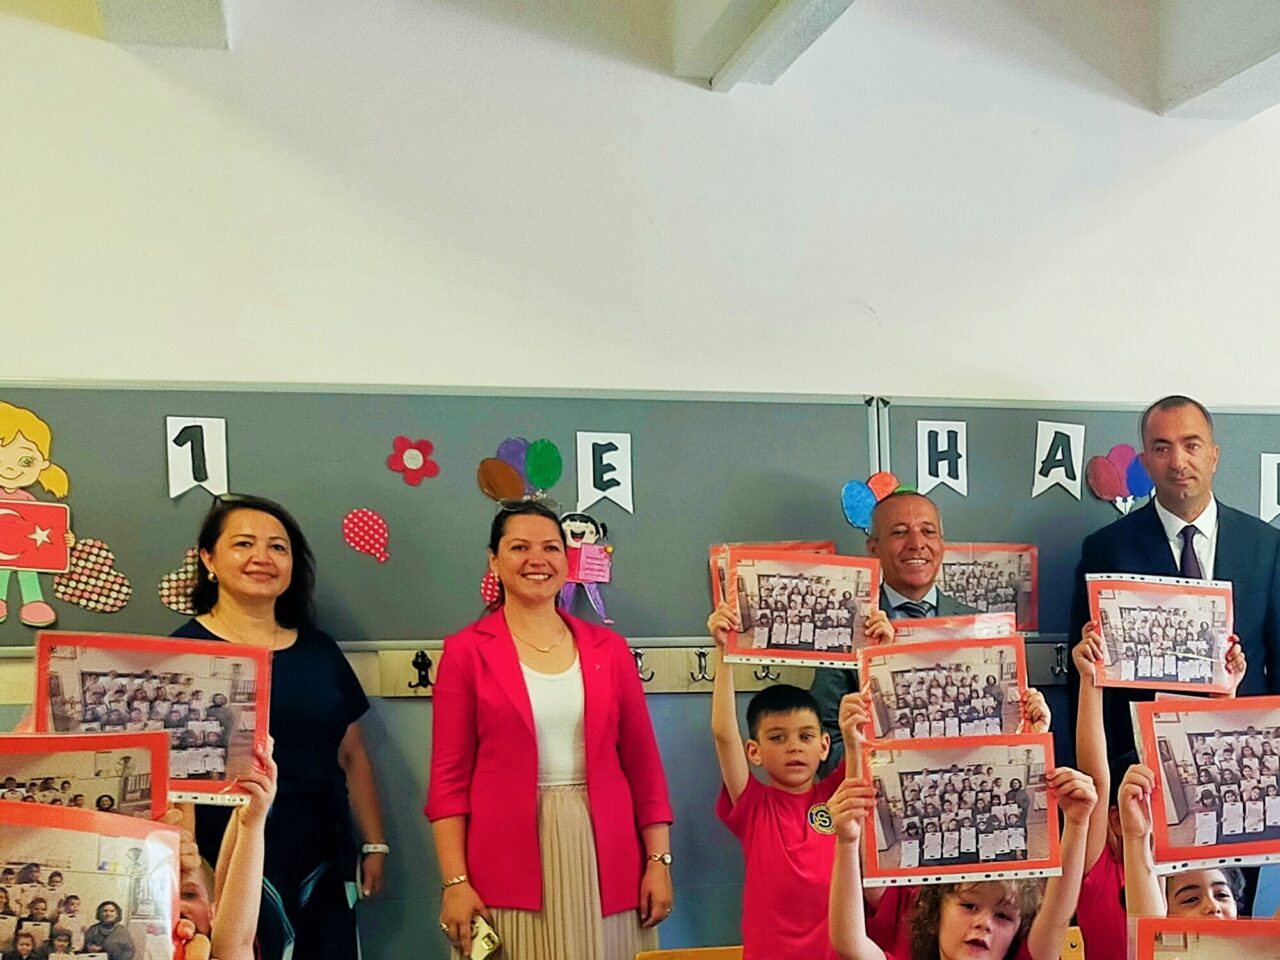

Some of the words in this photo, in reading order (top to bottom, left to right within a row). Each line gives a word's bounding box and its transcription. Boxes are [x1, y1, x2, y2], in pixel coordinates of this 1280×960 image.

[173, 425, 208, 482] 1
[592, 442, 620, 491] E
[928, 430, 962, 480] H
[1039, 431, 1076, 481] A
